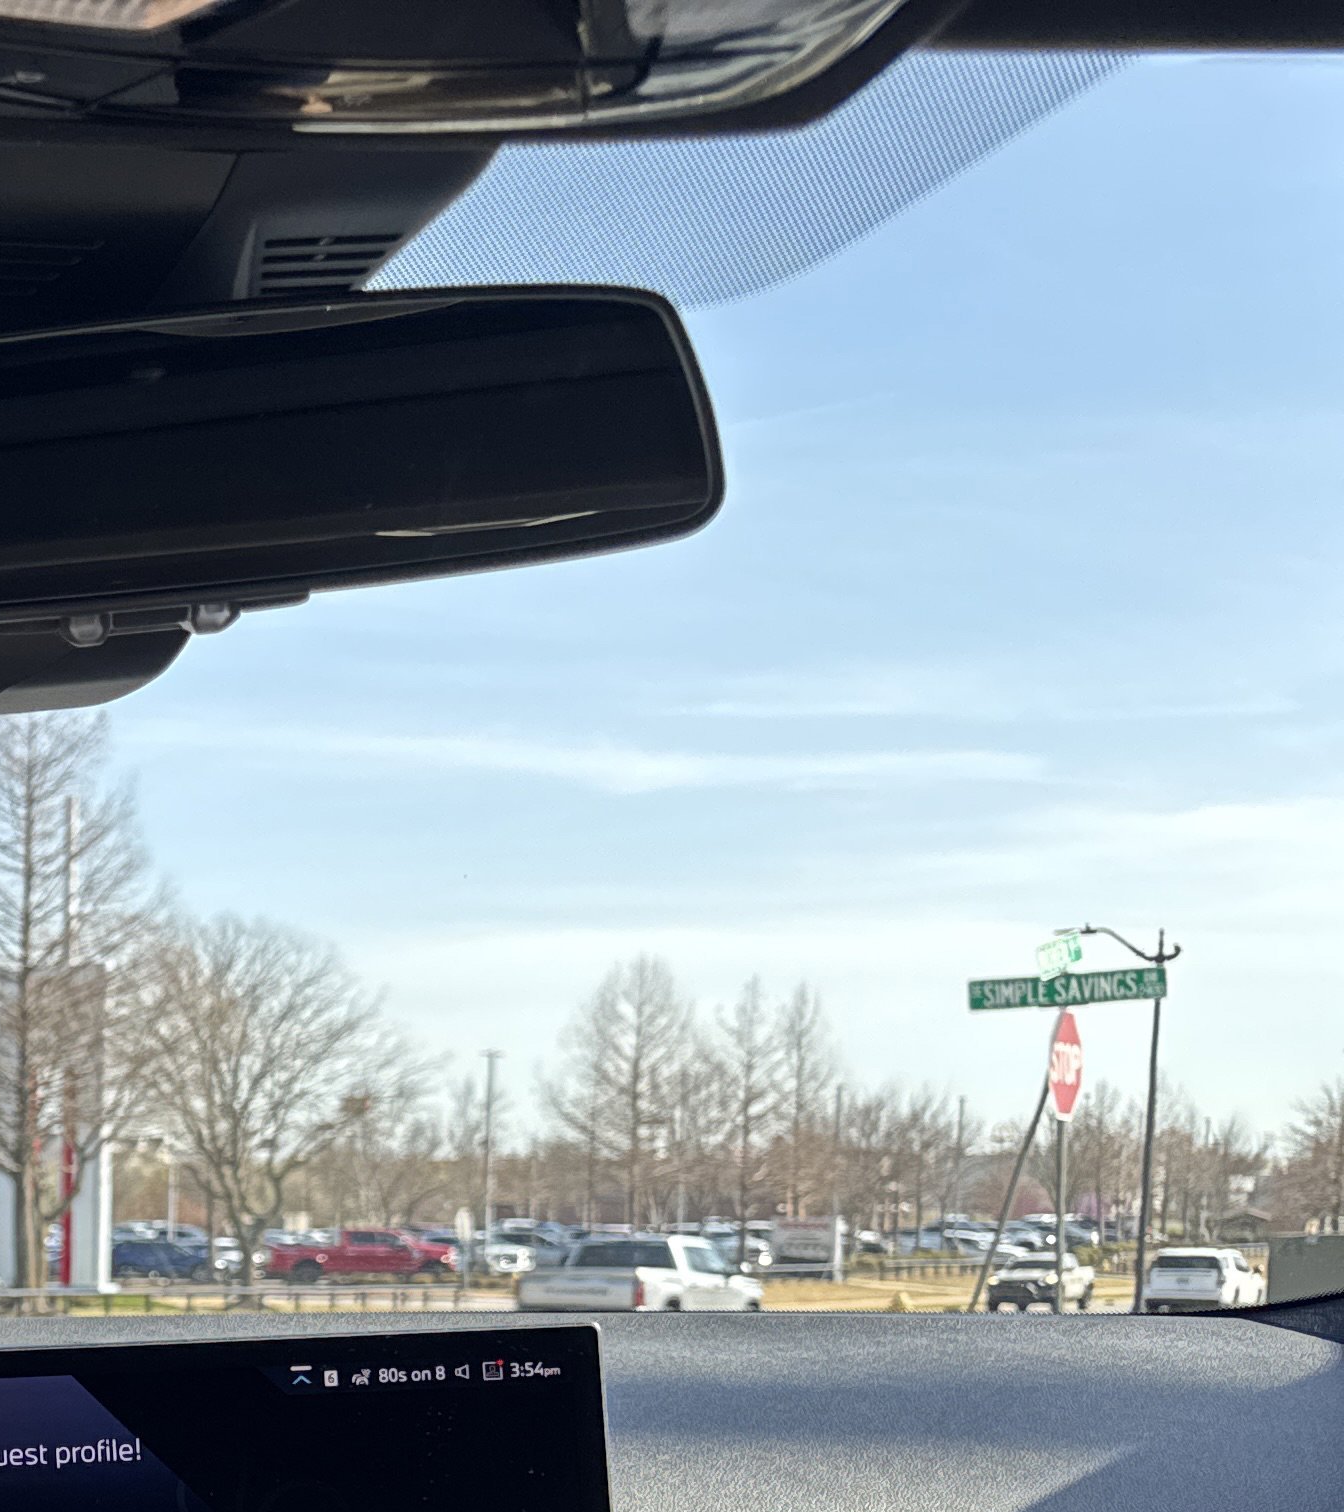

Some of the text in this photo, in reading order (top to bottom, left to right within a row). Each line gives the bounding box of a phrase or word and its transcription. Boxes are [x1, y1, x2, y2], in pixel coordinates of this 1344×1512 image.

[984, 979, 1048, 1007] SIMPLE
[1054, 973, 1138, 1003] SAVINGS
[1051, 1041, 1081, 1084] STOP
[379, 1365, 446, 1383] 80s on 8
[510, 1361, 562, 1379] 3:54pm
[56, 1438, 142, 1469] profile!
